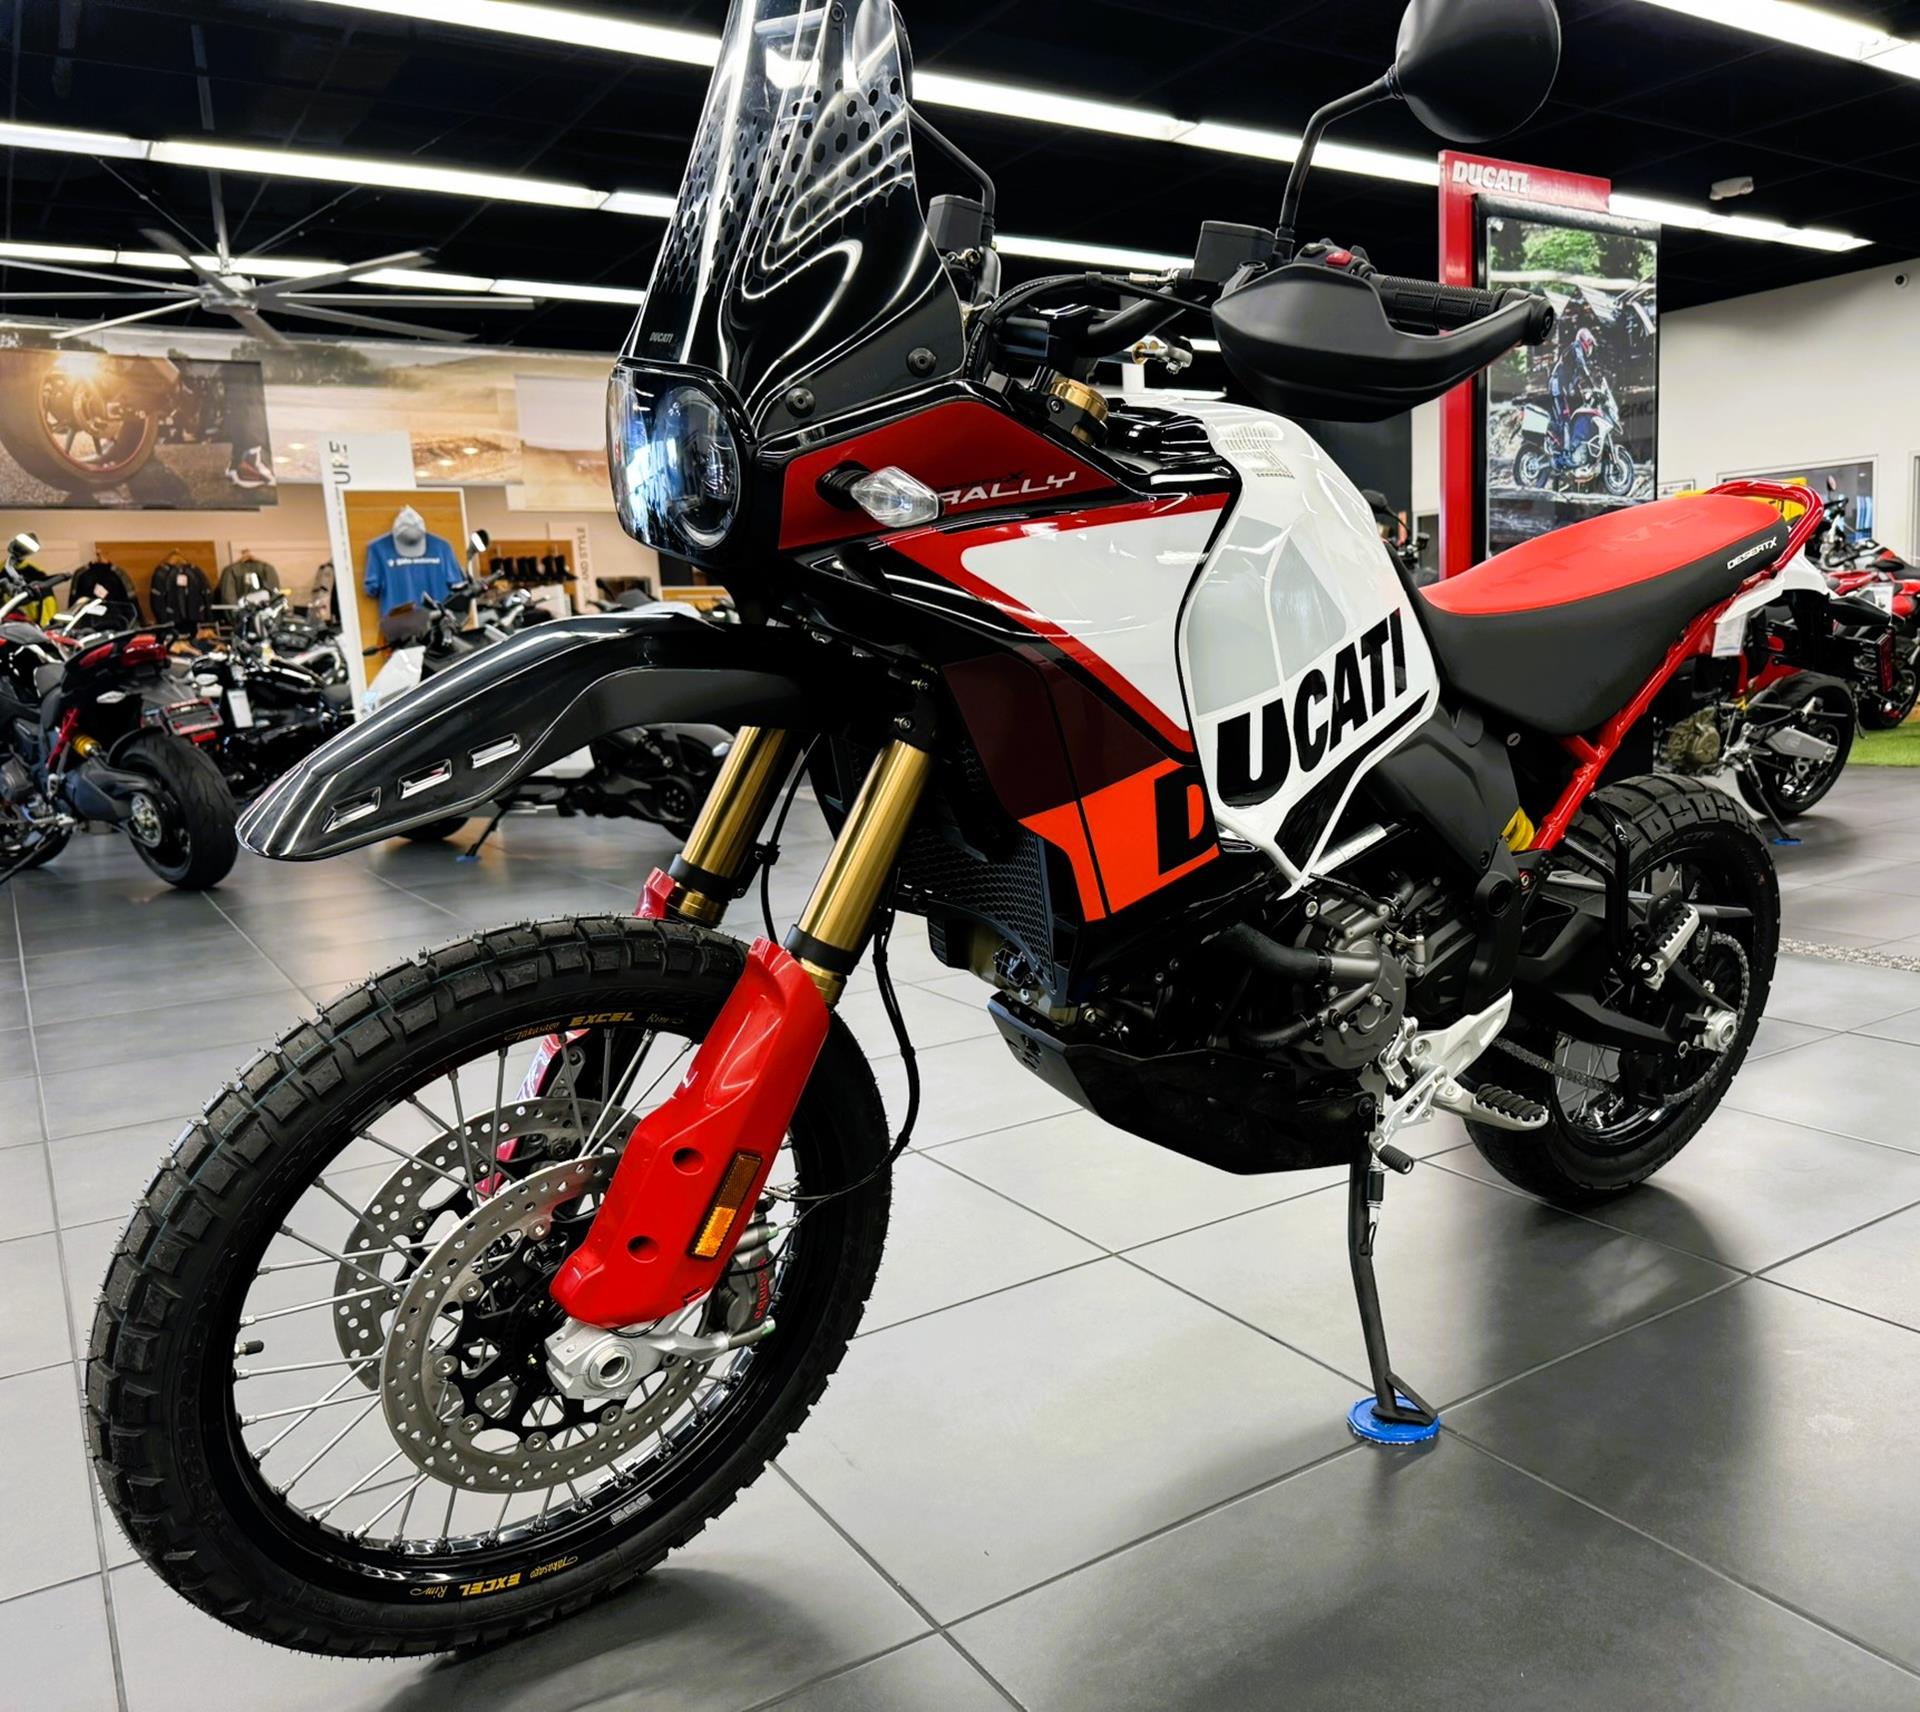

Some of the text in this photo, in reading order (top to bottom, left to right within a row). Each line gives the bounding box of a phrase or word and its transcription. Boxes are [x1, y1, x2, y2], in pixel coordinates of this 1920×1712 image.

[1452, 160, 1528, 193] DUCATI
[649, 331, 674, 343] DUCATI
[938, 471, 1076, 504] RALLY
[1727, 536, 1777, 570] DESERTX
[568, 1012, 635, 1027] EXCEL
[409, 1585, 448, 1599] Rim
[459, 1572, 522, 1597] EXCEL
